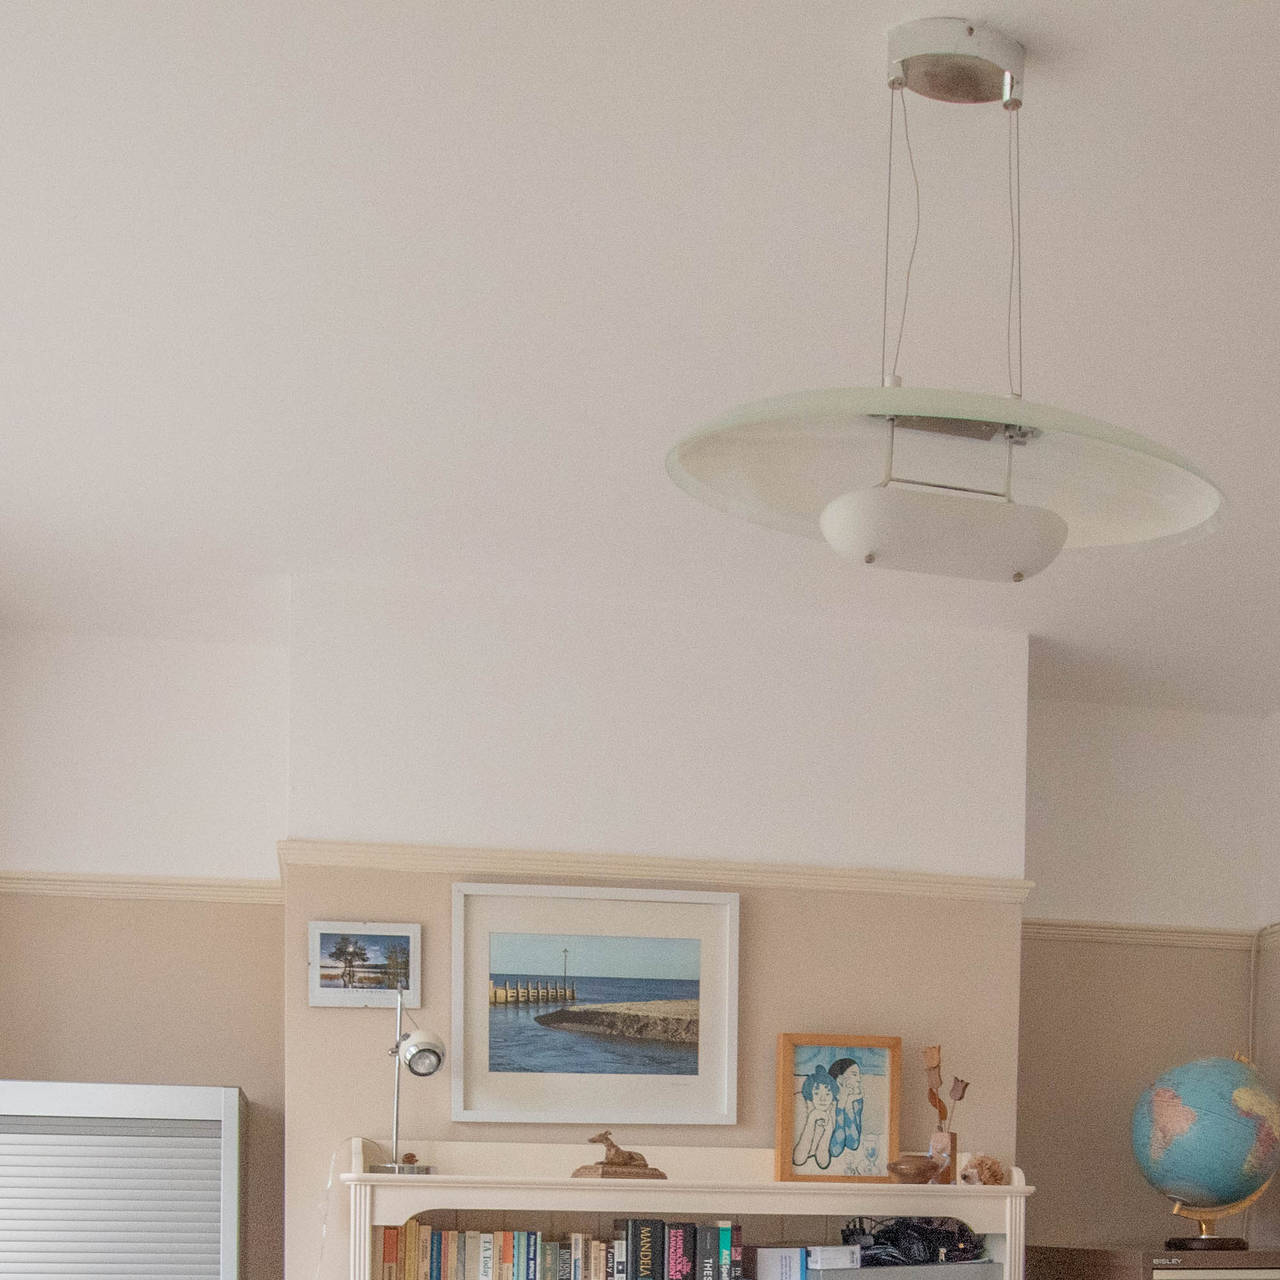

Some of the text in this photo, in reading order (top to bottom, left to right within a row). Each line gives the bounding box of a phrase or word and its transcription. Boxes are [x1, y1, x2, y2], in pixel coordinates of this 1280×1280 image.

[481, 1240, 492, 1277] TA Today
[639, 1227, 652, 1276] MANDELA
[669, 1230, 677, 1279] MANAGEMENT
[735, 1267, 741, 1275] IN
